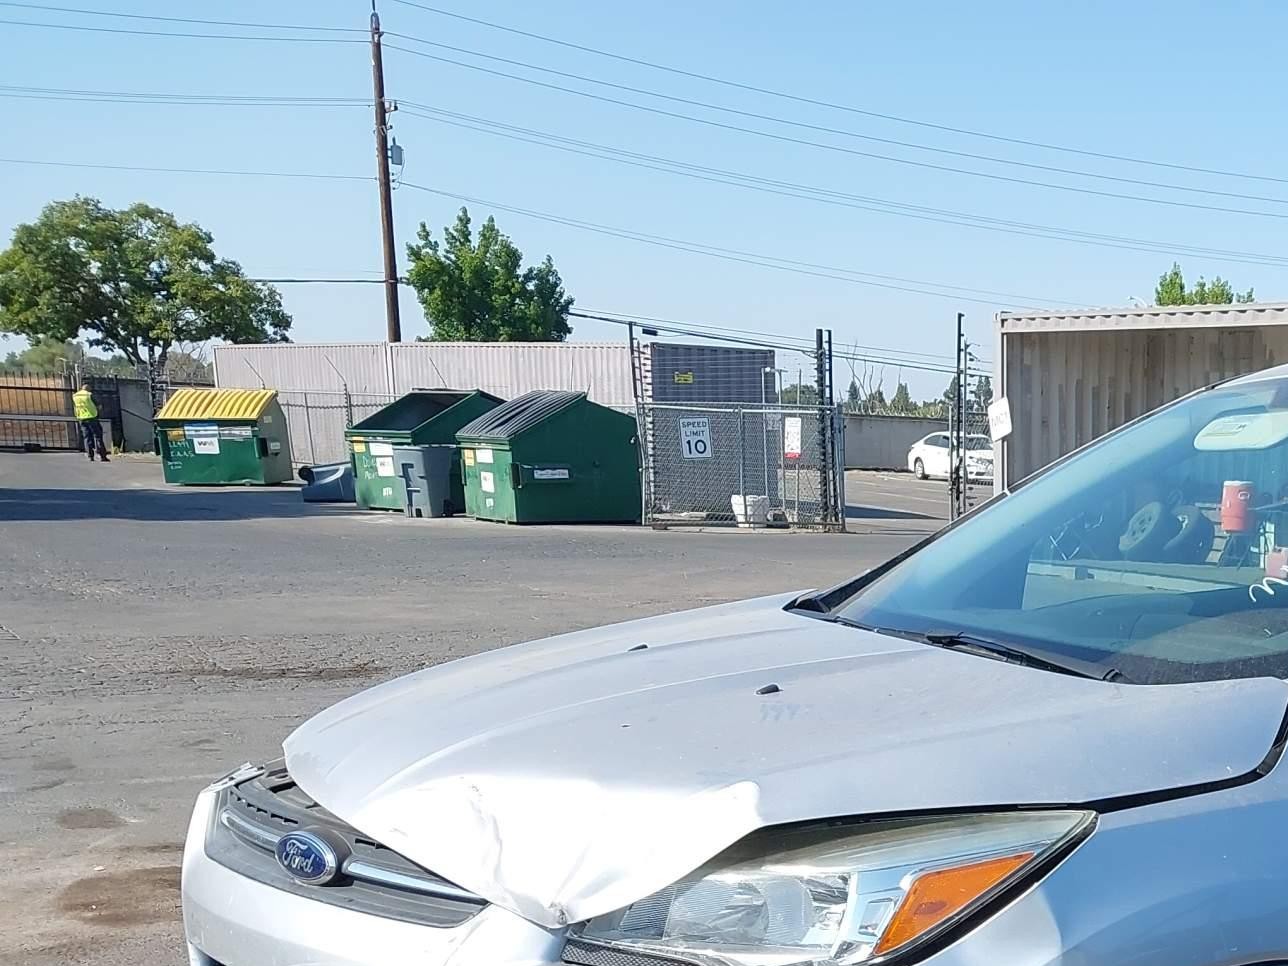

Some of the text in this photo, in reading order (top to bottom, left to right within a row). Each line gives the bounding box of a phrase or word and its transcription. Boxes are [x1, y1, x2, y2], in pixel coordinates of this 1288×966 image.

[681, 421, 707, 429] SPEED
[684, 430, 706, 438] LIMIT
[686, 439, 707, 455] 10
[282, 839, 316, 873] Ford
